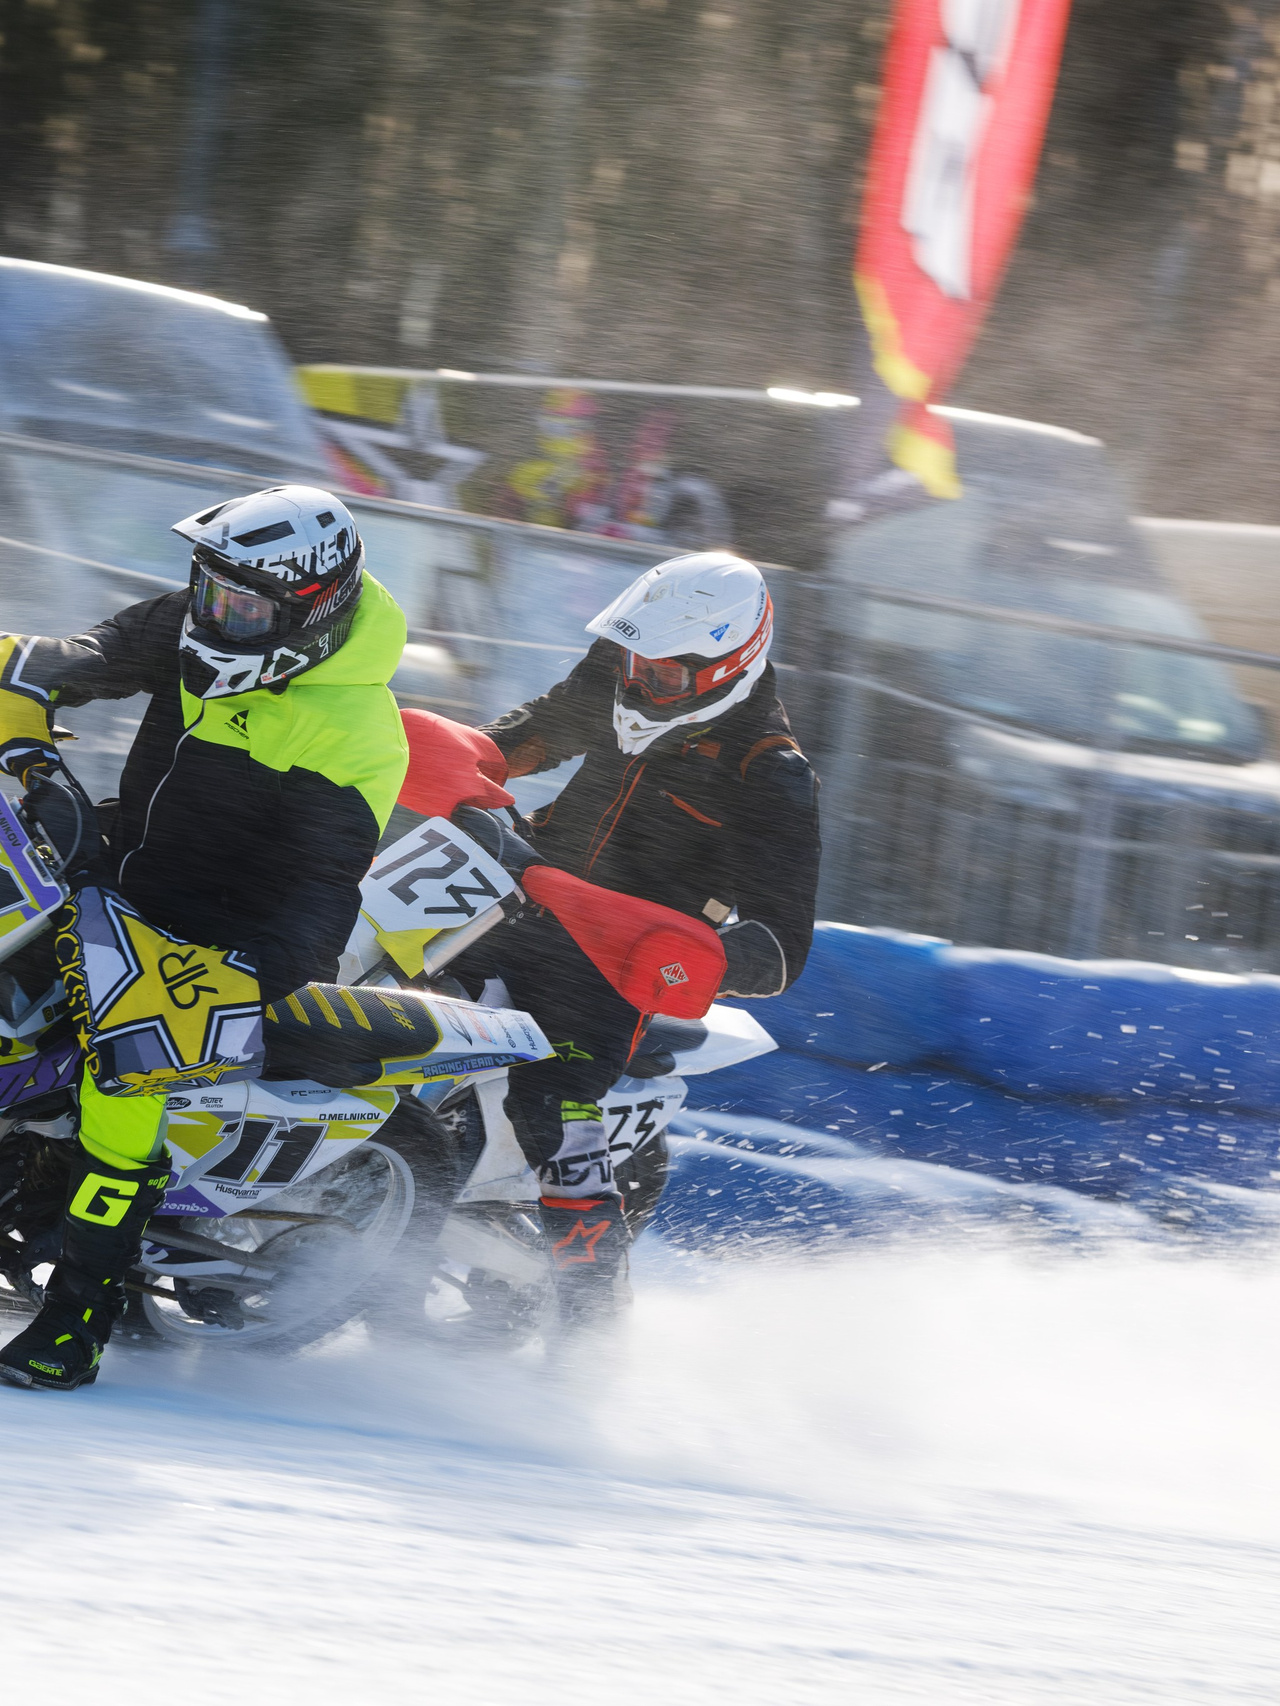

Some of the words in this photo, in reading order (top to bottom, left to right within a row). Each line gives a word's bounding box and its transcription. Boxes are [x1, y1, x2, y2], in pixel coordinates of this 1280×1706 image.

[602, 618, 637, 638] SHOEI
[712, 608, 772, 682] LS2
[223, 721, 250, 740] FISCHER
[368, 827, 503, 919] 123
[423, 1062, 462, 1078] RACING
[463, 1055, 495, 1072] TEAM
[318, 1112, 381, 1121] D.MELNIKOV
[201, 1118, 328, 1186] 11
[68, 1172, 140, 1228] G
[215, 1183, 262, 1197] Husqvarna
[161, 1202, 210, 1214] rembo
